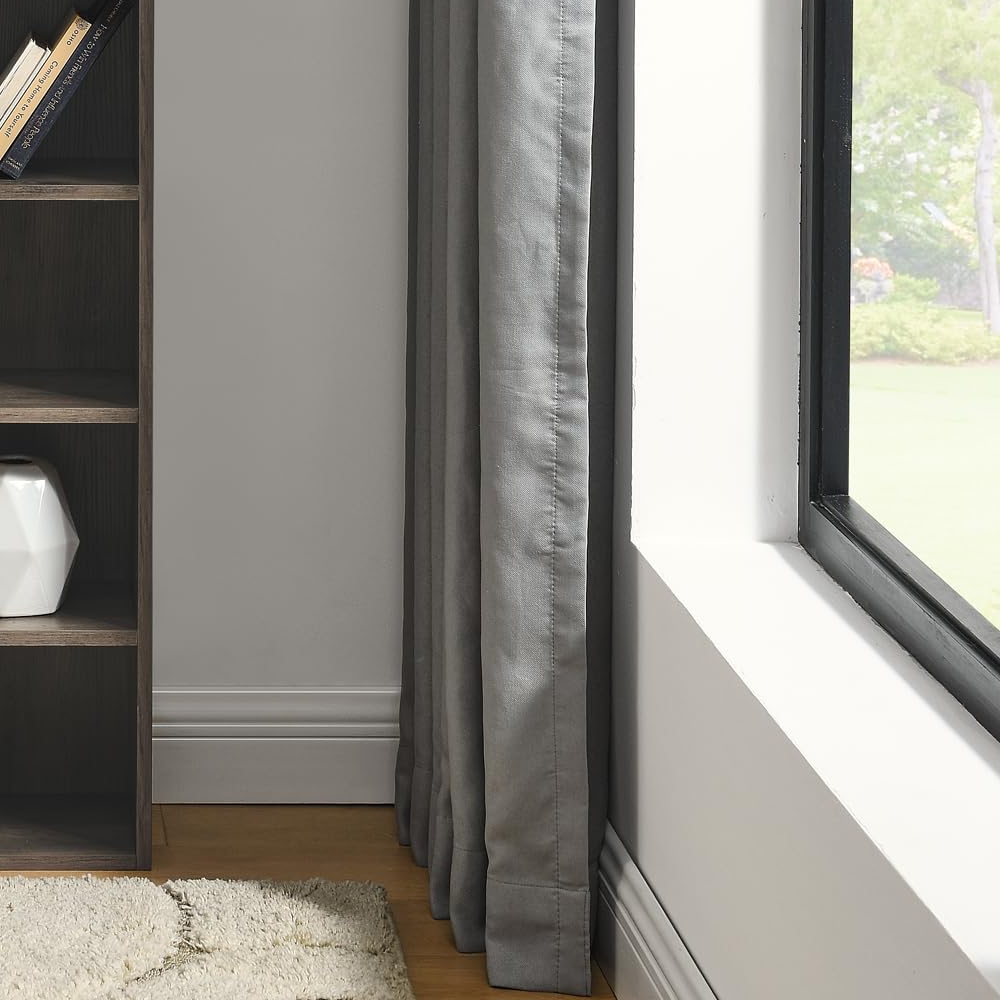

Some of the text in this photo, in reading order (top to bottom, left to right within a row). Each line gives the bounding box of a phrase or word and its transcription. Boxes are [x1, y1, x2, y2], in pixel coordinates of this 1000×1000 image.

[66, 29, 79, 46] OSHO
[86, 40, 96, 51] to
[77, 48, 91, 64] Win
[38, 60, 59, 85] Coming
[62, 61, 82, 86] Friends
[26, 84, 42, 104] Home
[20, 103, 28, 112] to
[4, 112, 24, 137] Yourself
[20, 126, 41, 150] People
